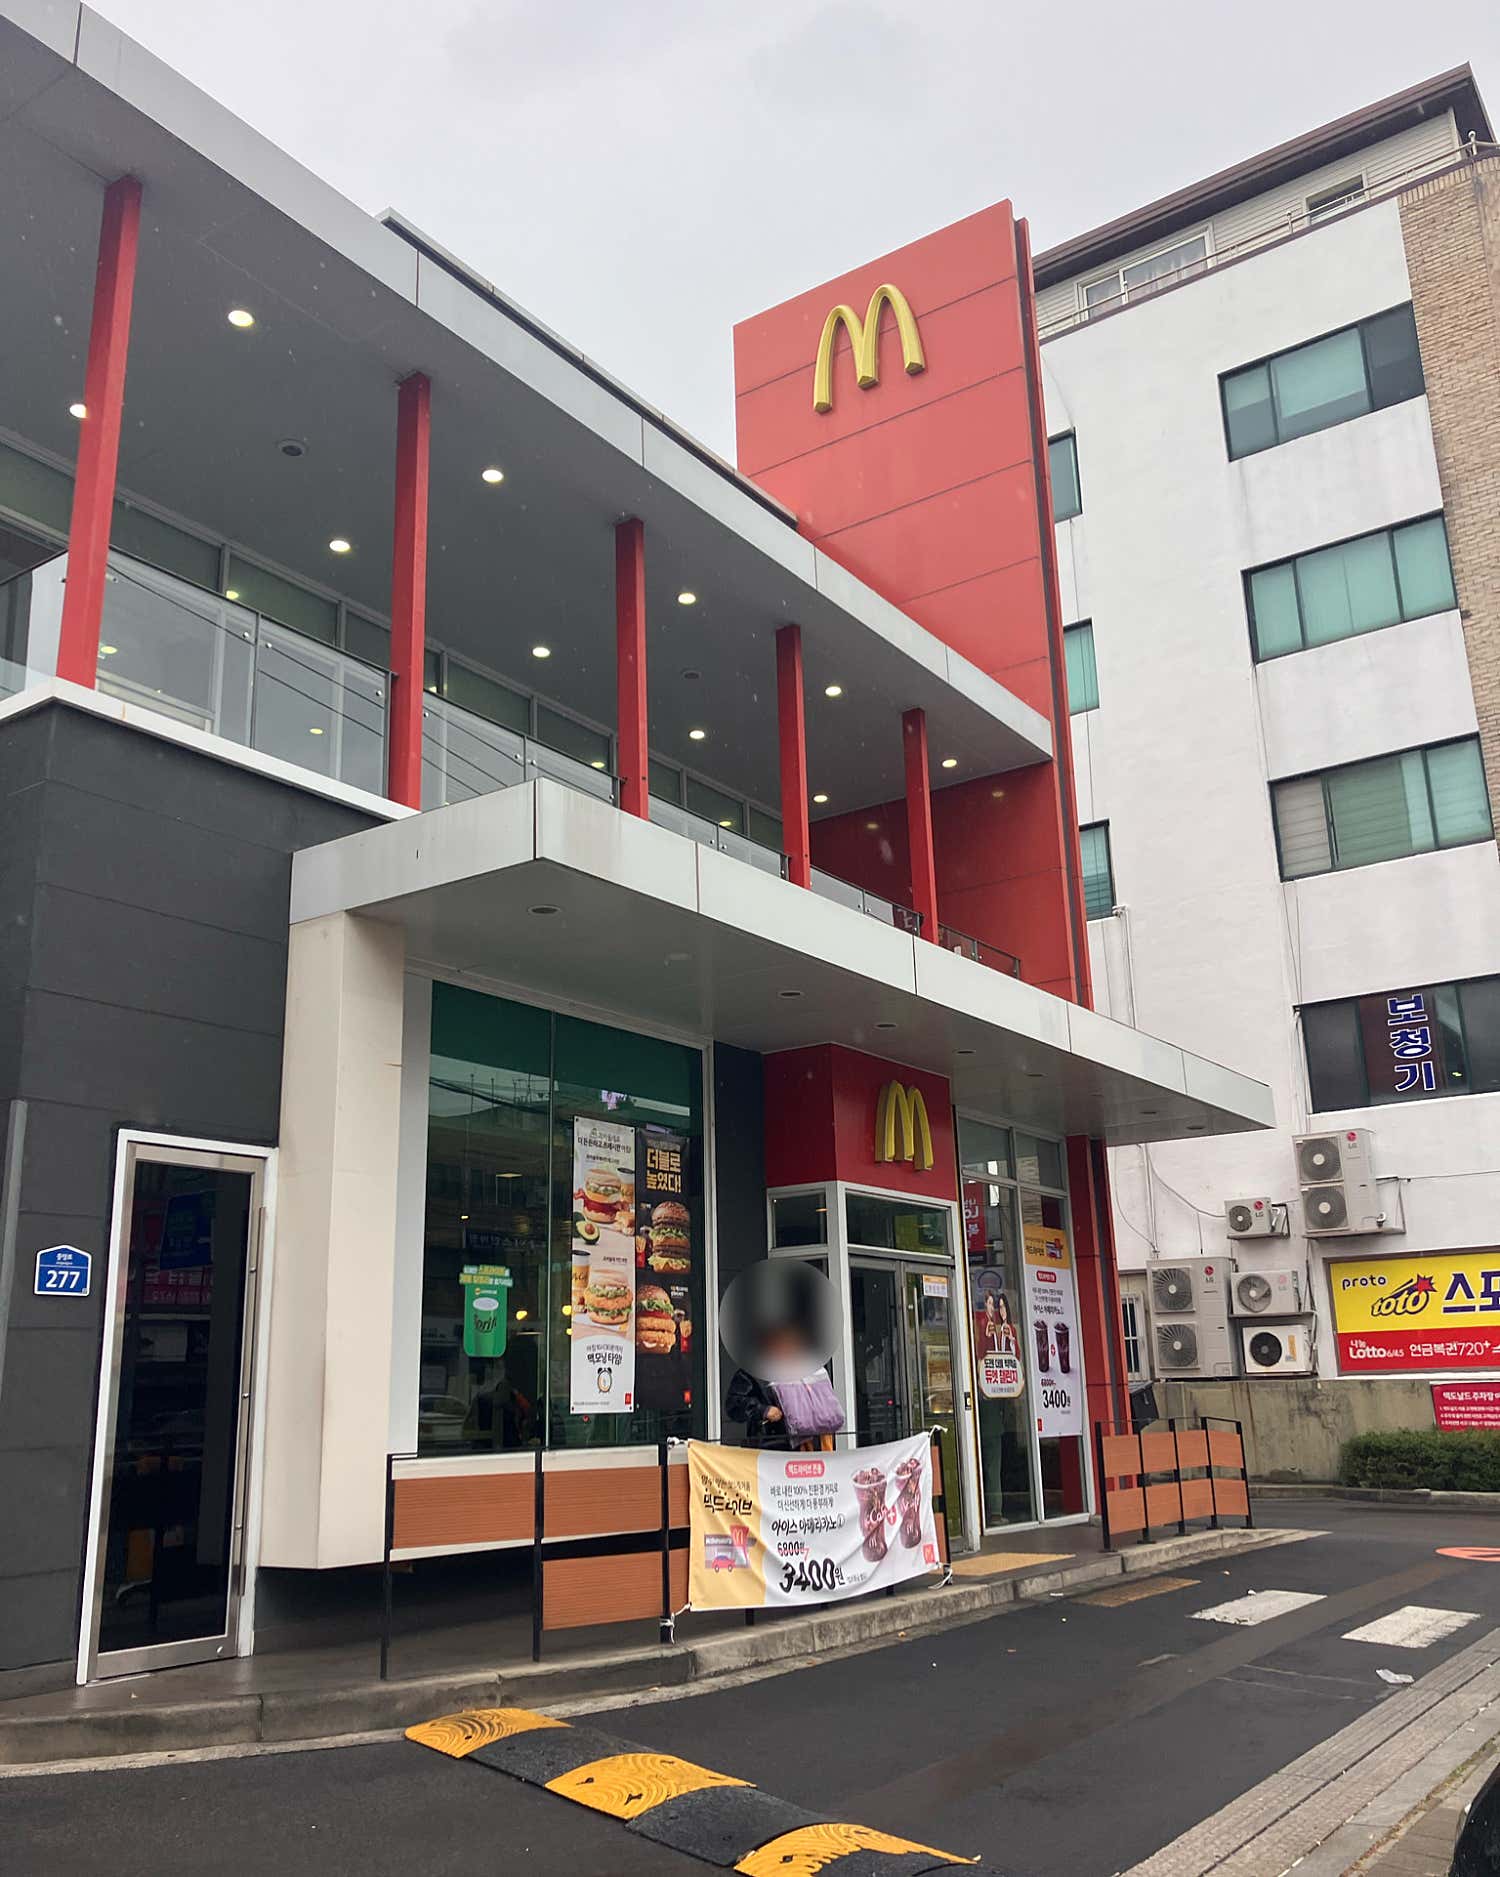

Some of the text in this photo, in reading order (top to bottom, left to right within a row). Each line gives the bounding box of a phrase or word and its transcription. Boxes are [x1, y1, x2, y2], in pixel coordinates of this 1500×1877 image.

[1387, 993, 1436, 1092] 보청기
[647, 1147, 681, 1172] 더블로
[647, 1170, 681, 1193] 높였다!
[46, 1270, 80, 1289] 277
[1342, 1274, 1387, 1291] proto
[1371, 1289, 1430, 1317] toto
[587, 1352, 607, 1365] 맥모닝
[771, 1518, 798, 1537] 아이스
[779, 1558, 846, 1594] 3400원
